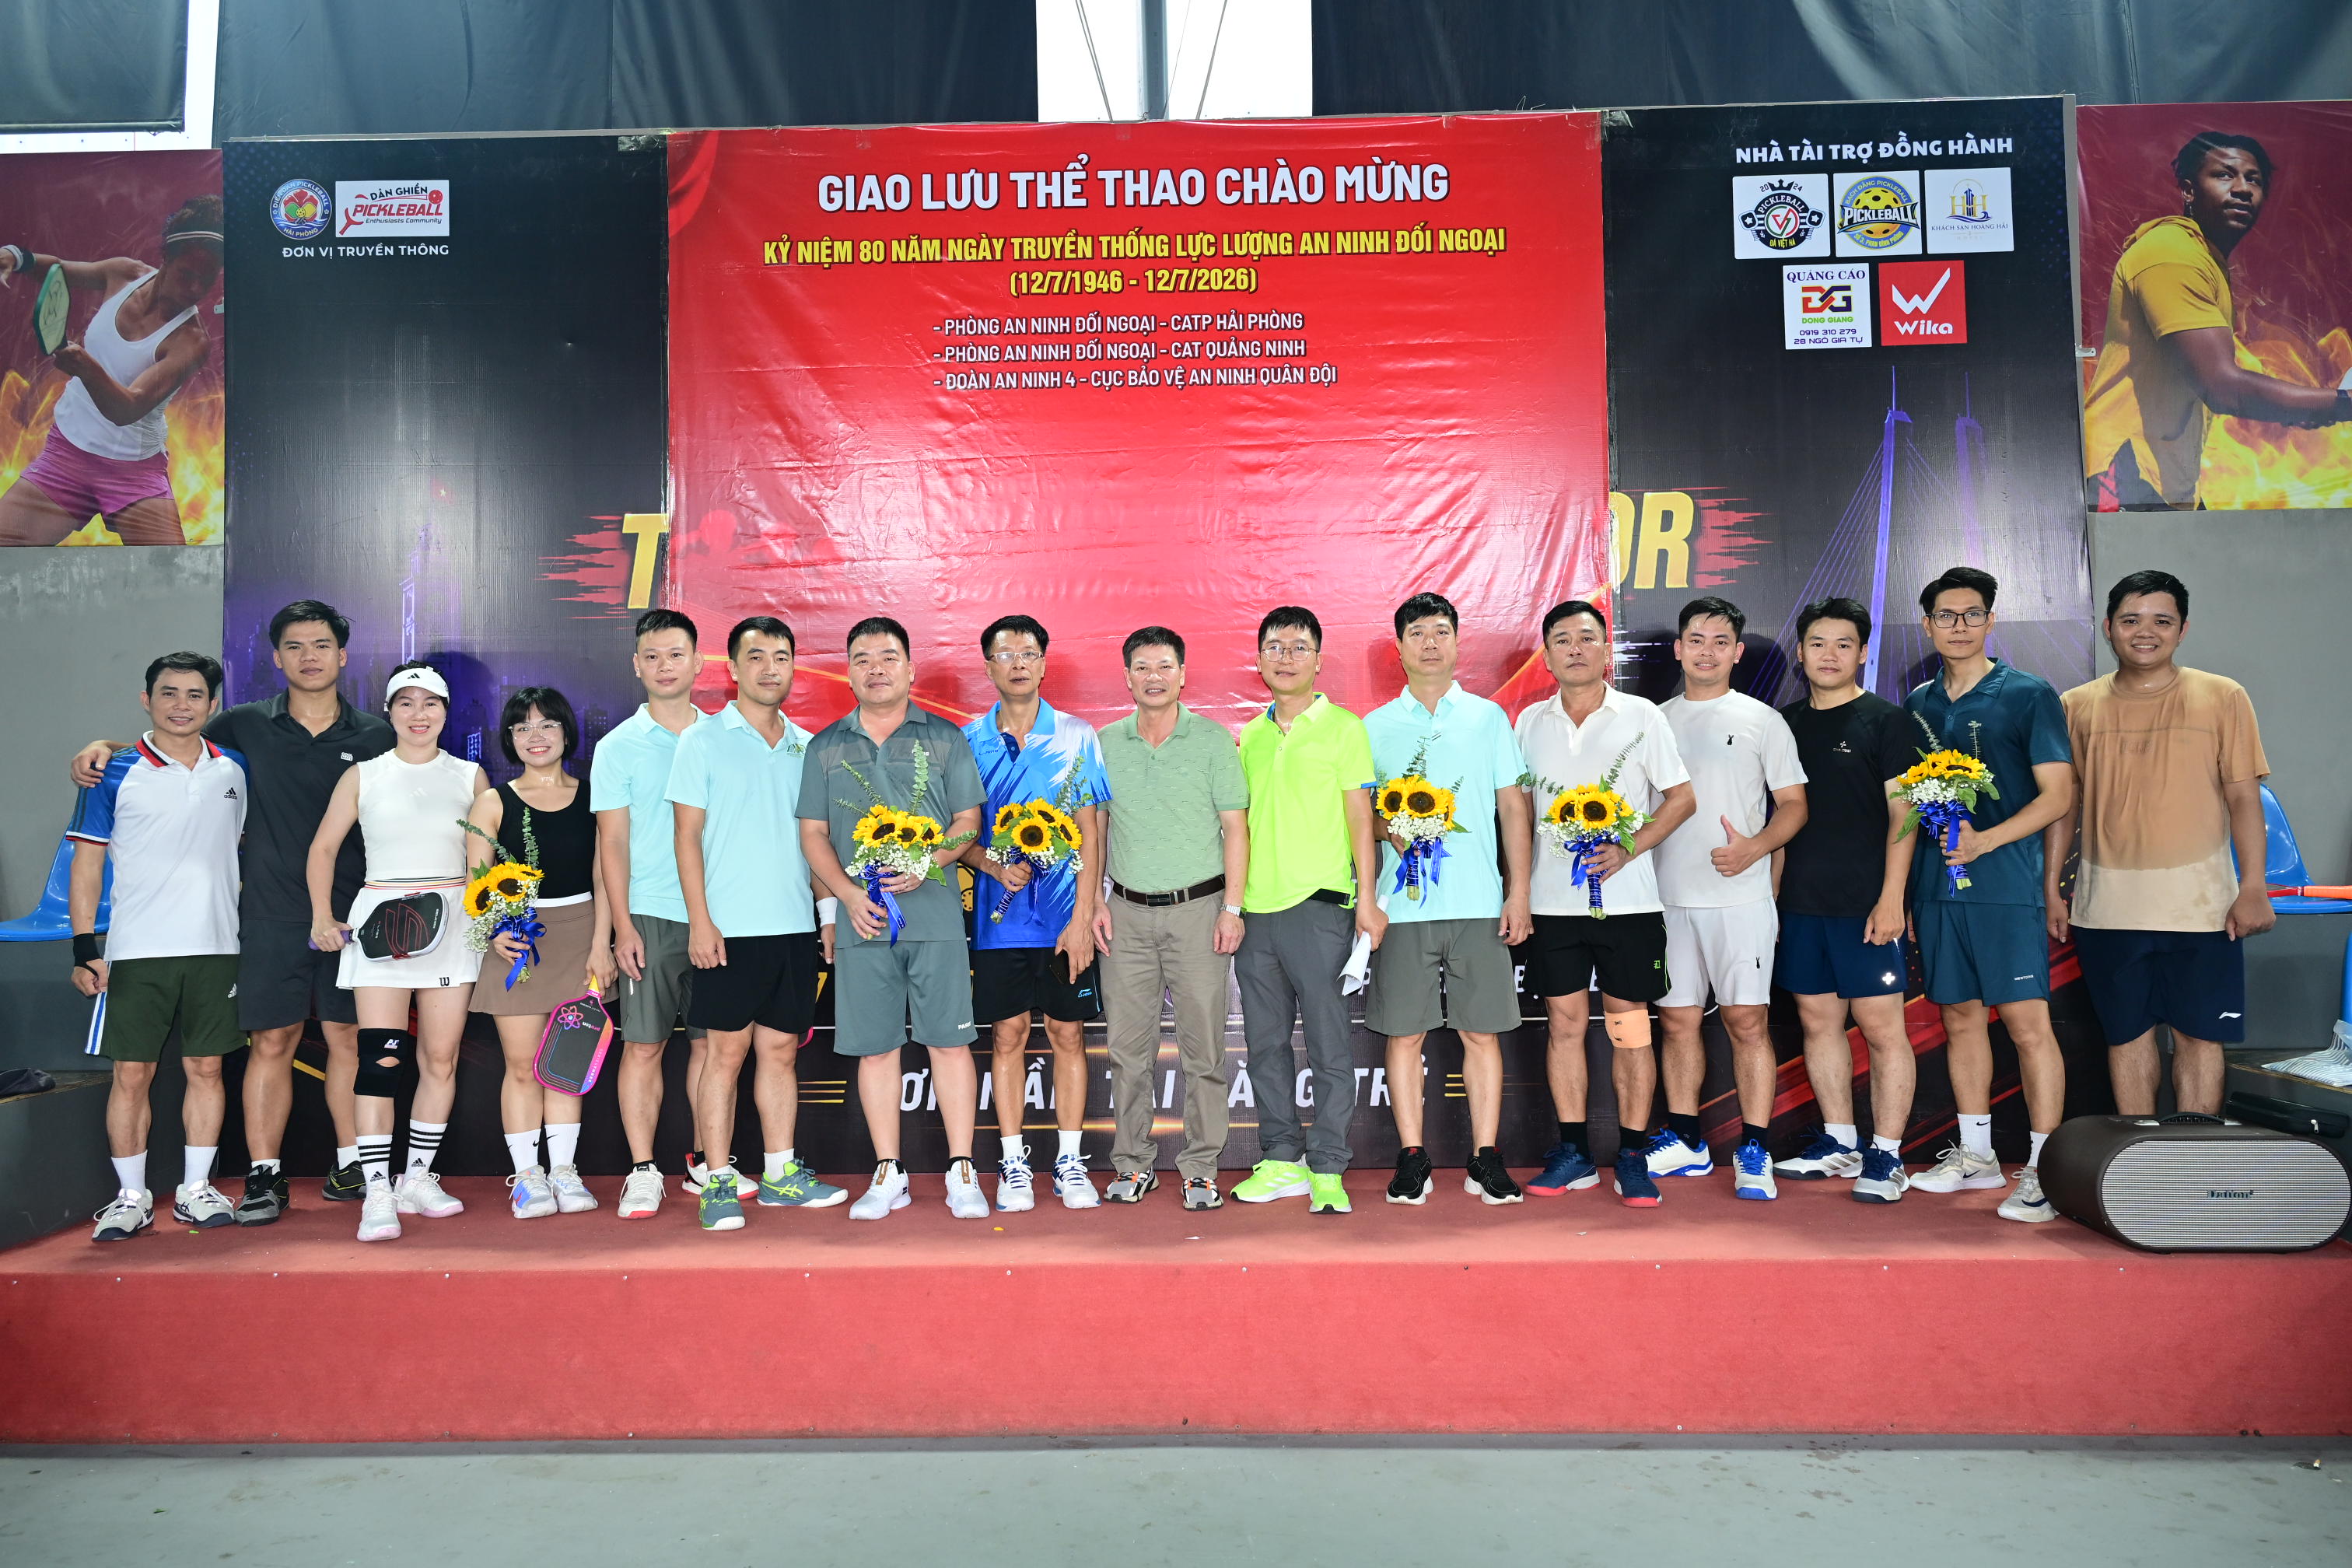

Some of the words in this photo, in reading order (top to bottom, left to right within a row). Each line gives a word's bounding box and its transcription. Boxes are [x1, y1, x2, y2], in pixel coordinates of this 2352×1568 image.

[1736, 139, 1784, 163] NHÀ
[1789, 138, 1823, 161] TÀI
[1829, 141, 1873, 164] TRỢ
[1878, 131, 1943, 158] ĐỒNG
[1948, 132, 2013, 156] HÀNH
[370, 188, 393, 201] DÂN
[818, 173, 912, 212] GIAO
[922, 169, 999, 211] LƯU
[1009, 153, 1090, 209] THỂ
[1097, 168, 1206, 207] THAO
[1216, 158, 1325, 205] CHÀO
[1335, 156, 1449, 203] MỪNG
[352, 202, 443, 217] PICKLEBALL
[1757, 195, 1805, 214] PICKLEBALL
[1843, 205, 1918, 227] PICKLEBALL
[282, 245, 314, 257] ĐƠN
[319, 247, 333, 259] VỊ
[338, 242, 394, 257] TRUYỀN
[399, 243, 449, 256] THÔNG
[764, 234, 792, 264] KỶ
[797, 236, 853, 268] NIỆM
[859, 240, 885, 263] 80
[891, 234, 942, 262] NĂM
[947, 233, 1006, 261] NGÀY
[1011, 229, 1093, 260] TRUYỀN
[1099, 226, 1170, 258] THỐNG
[1176, 233, 1216, 261] LỰC
[1222, 230, 1293, 261] LƯỢNG
[1299, 232, 1329, 255] AN
[1336, 230, 1390, 254] NINH
[1395, 222, 1433, 253] ĐỐI
[1438, 228, 1506, 256] NGOẠI
[1010, 271, 1123, 297] (12/7/1946
[1145, 268, 1258, 292] 12/7/2026)
[1787, 269, 1834, 283] QUẢNG
[1838, 268, 1866, 280] CÁO
[945, 316, 1000, 335] PHÒNG
[1003, 317, 1027, 334] AN
[1031, 317, 1071, 334] NINH
[1076, 311, 1102, 333] ĐỐI
[1107, 315, 1157, 336] NGOẠI
[1171, 314, 1213, 331] CATP
[1216, 310, 1244, 331] HẢI
[1248, 310, 1304, 330] PHÒNG
[1894, 320, 1953, 335] Wika
[945, 342, 1000, 362] PHÒNG
[1003, 345, 1027, 362] AN
[1031, 344, 1071, 361] NINH
[1076, 338, 1103, 359] ĐỐI
[1107, 342, 1157, 363] NGOẠI
[1171, 341, 1202, 358] CAT
[1206, 336, 1262, 360] QUẢNG
[1265, 340, 1306, 357] NINH
[946, 369, 991, 390] ĐOÀN
[994, 372, 1018, 389] AN
[1022, 371, 1062, 388] NINH
[1065, 371, 1076, 387] 4
[1090, 370, 1124, 391] CỤC
[1128, 365, 1160, 387] BẢO
[1164, 366, 1185, 390] VỆ
[1189, 369, 1212, 386] AN
[1216, 368, 1256, 385] NINH
[1260, 363, 1304, 387] QUÂN
[1309, 362, 1338, 387] ĐỘI
